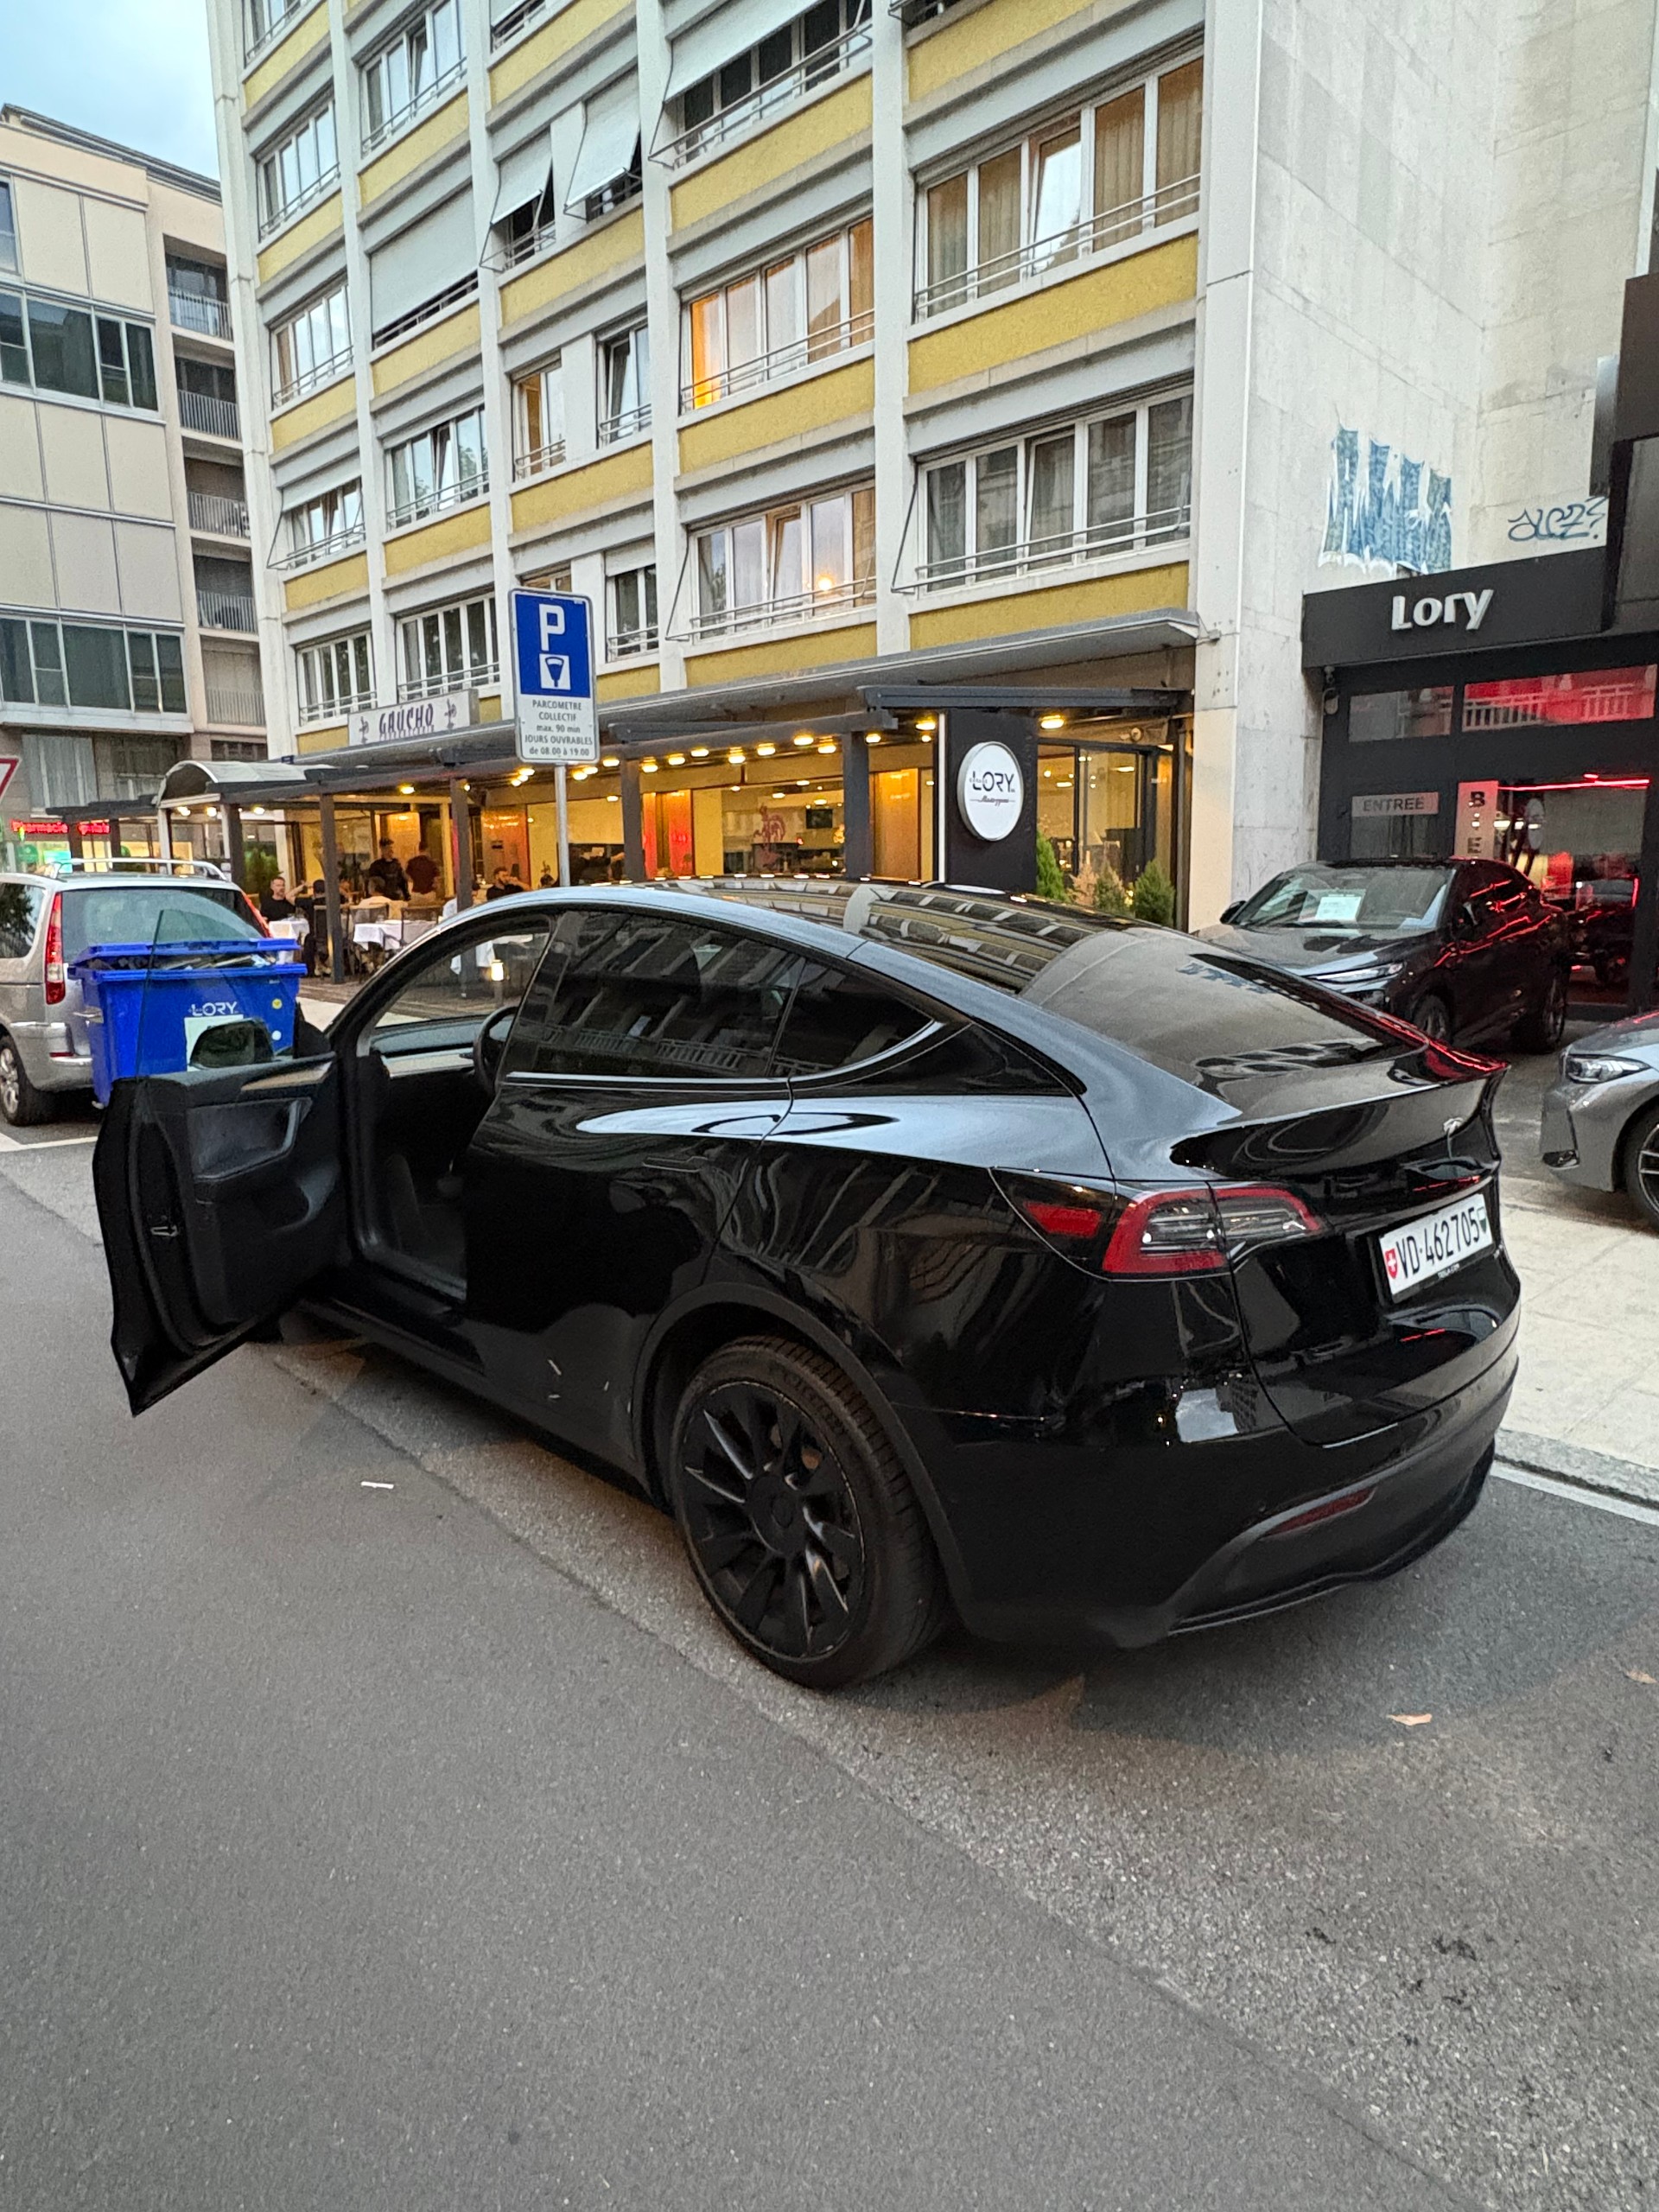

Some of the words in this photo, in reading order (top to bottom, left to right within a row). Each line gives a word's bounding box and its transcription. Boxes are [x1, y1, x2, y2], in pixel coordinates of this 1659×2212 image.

[1391, 589, 1494, 630] Lory
[539, 603, 565, 652] P
[532, 699, 582, 710] PARCOMETRE
[538, 711, 576, 721] COLLECTIF
[556, 724, 565, 733] 90
[524, 734, 548, 743] JOURS
[550, 735, 593, 745] OUVRABLES
[529, 747, 538, 755] de
[972, 771, 1014, 792] LORY
[190, 1001, 238, 1016] LORY
